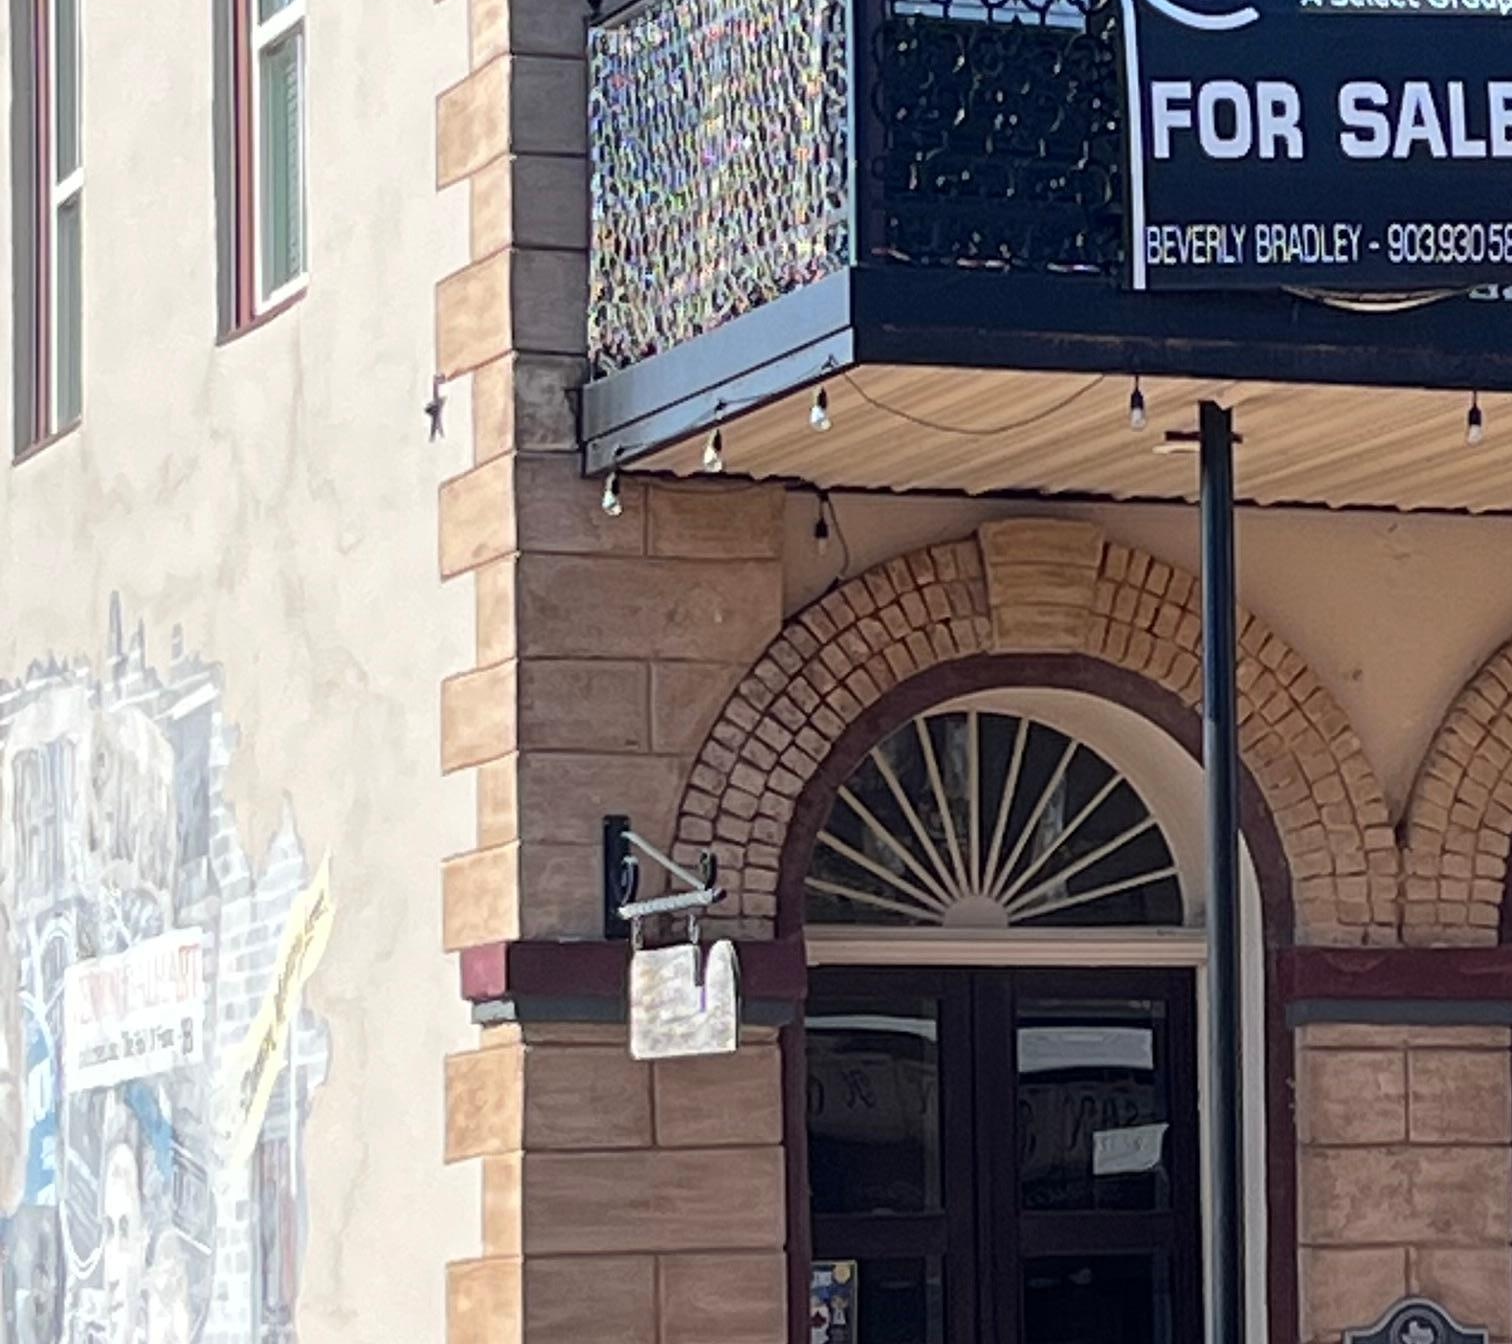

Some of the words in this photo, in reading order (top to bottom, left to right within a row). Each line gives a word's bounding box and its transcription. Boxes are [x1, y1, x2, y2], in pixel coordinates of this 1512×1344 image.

[1151, 81, 1304, 160] FOR
[1147, 224, 1248, 265] BEVERLY
[1255, 224, 1362, 264] BRADLEY
